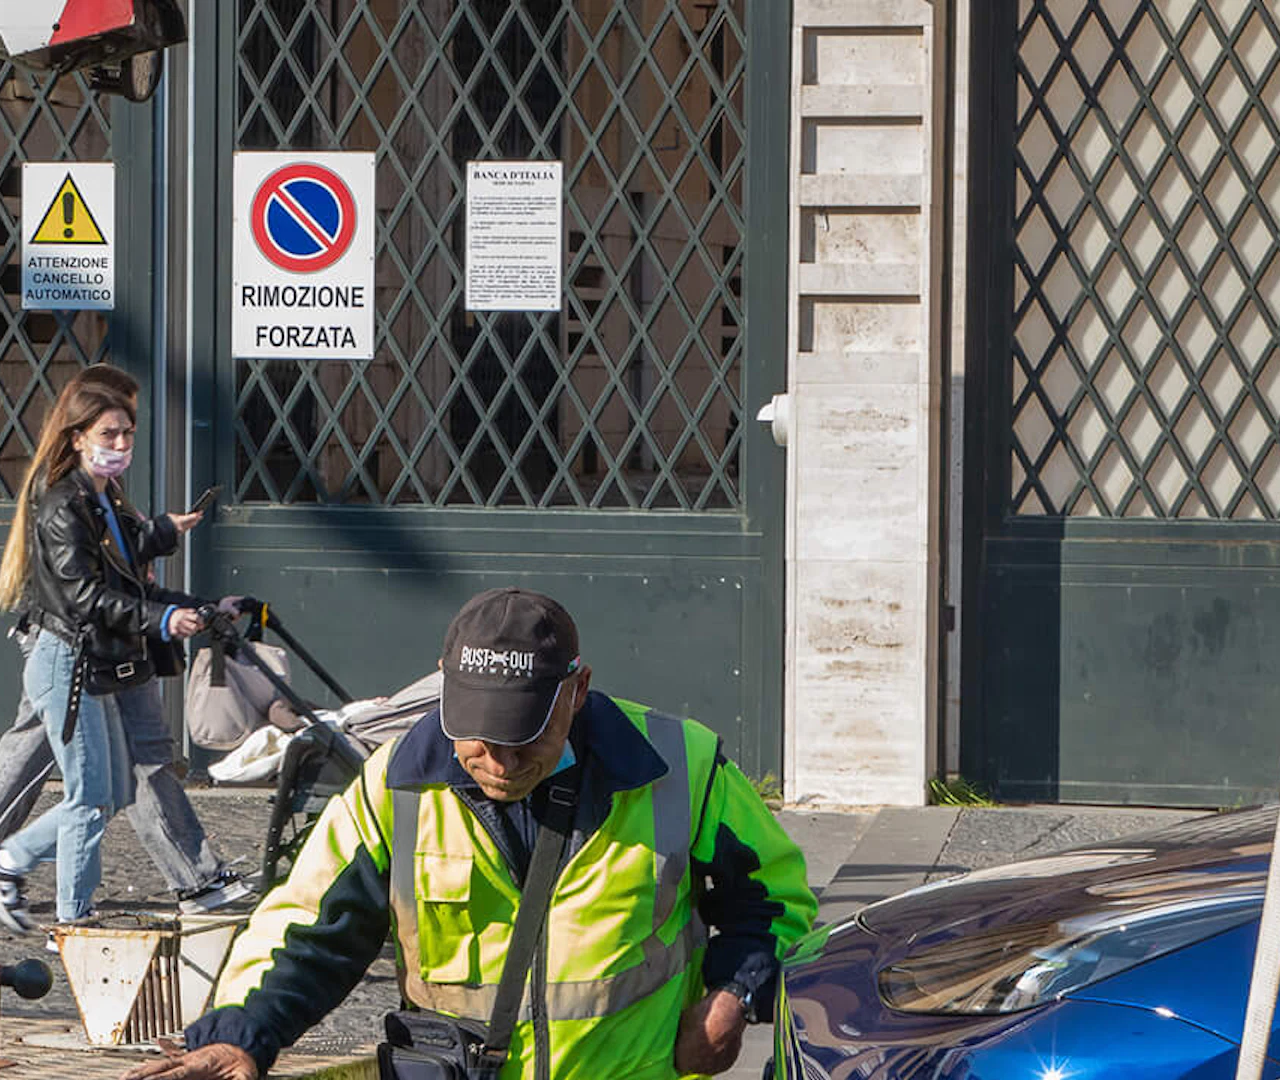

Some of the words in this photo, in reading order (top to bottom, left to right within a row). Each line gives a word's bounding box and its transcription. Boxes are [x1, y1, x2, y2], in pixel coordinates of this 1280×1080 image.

[473, 171, 508, 180] BANCA
[510, 170, 555, 180] D'ITALIA
[28, 257, 109, 269] ATTENZIONE
[32, 273, 104, 285] CANCELLO
[26, 288, 112, 301] AUTOMATICO
[241, 284, 365, 309] RIMOZIONE
[256, 325, 357, 349] FORZATA
[460, 645, 490, 666] BUST
[509, 650, 535, 670] OUT
